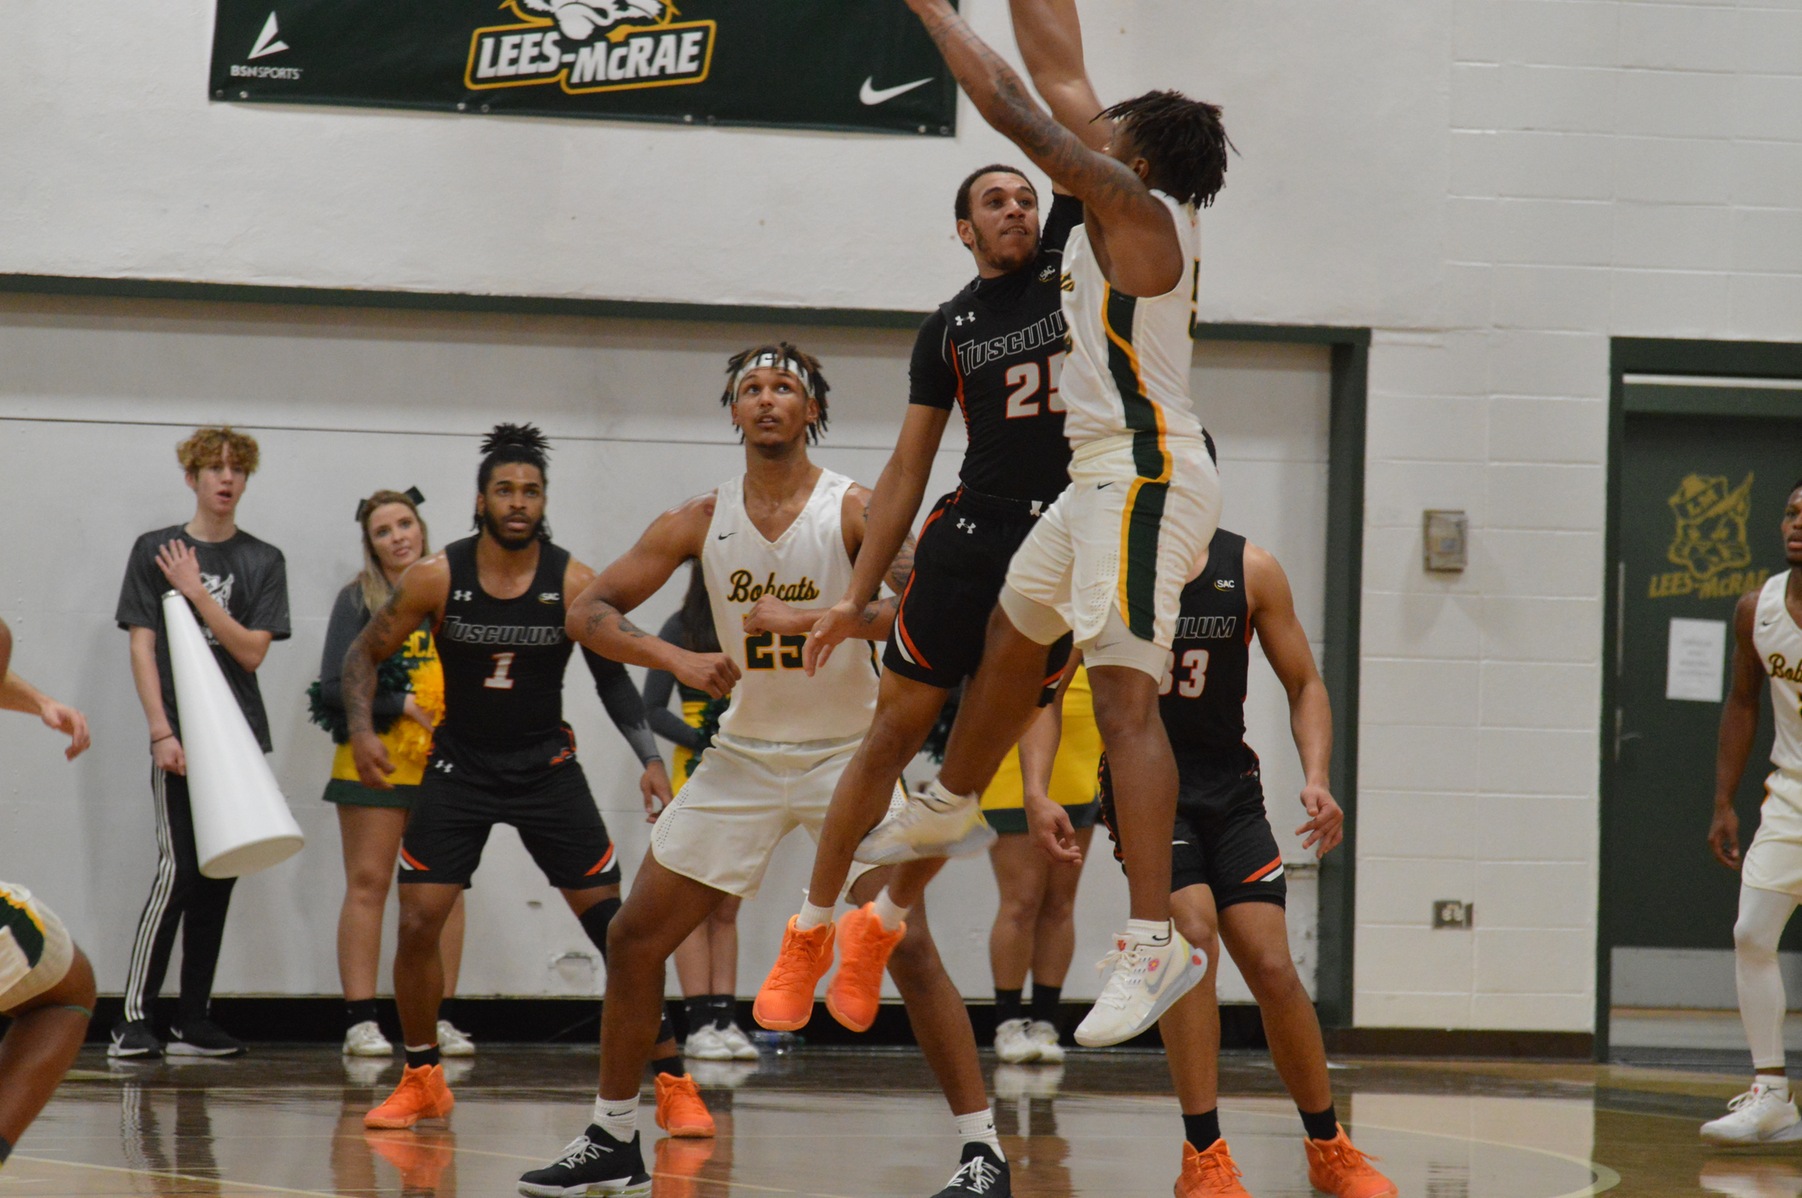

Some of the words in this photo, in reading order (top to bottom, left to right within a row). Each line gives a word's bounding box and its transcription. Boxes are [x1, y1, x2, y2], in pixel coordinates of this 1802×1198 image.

[957, 308, 1069, 376] TUSCULU
[727, 569, 820, 603] Bobcats
[1217, 580, 1235, 588] SAC
[444, 615, 565, 646] TUSCULUM
[1174, 616, 1237, 639] ULUM
[483, 652, 516, 689] 1
